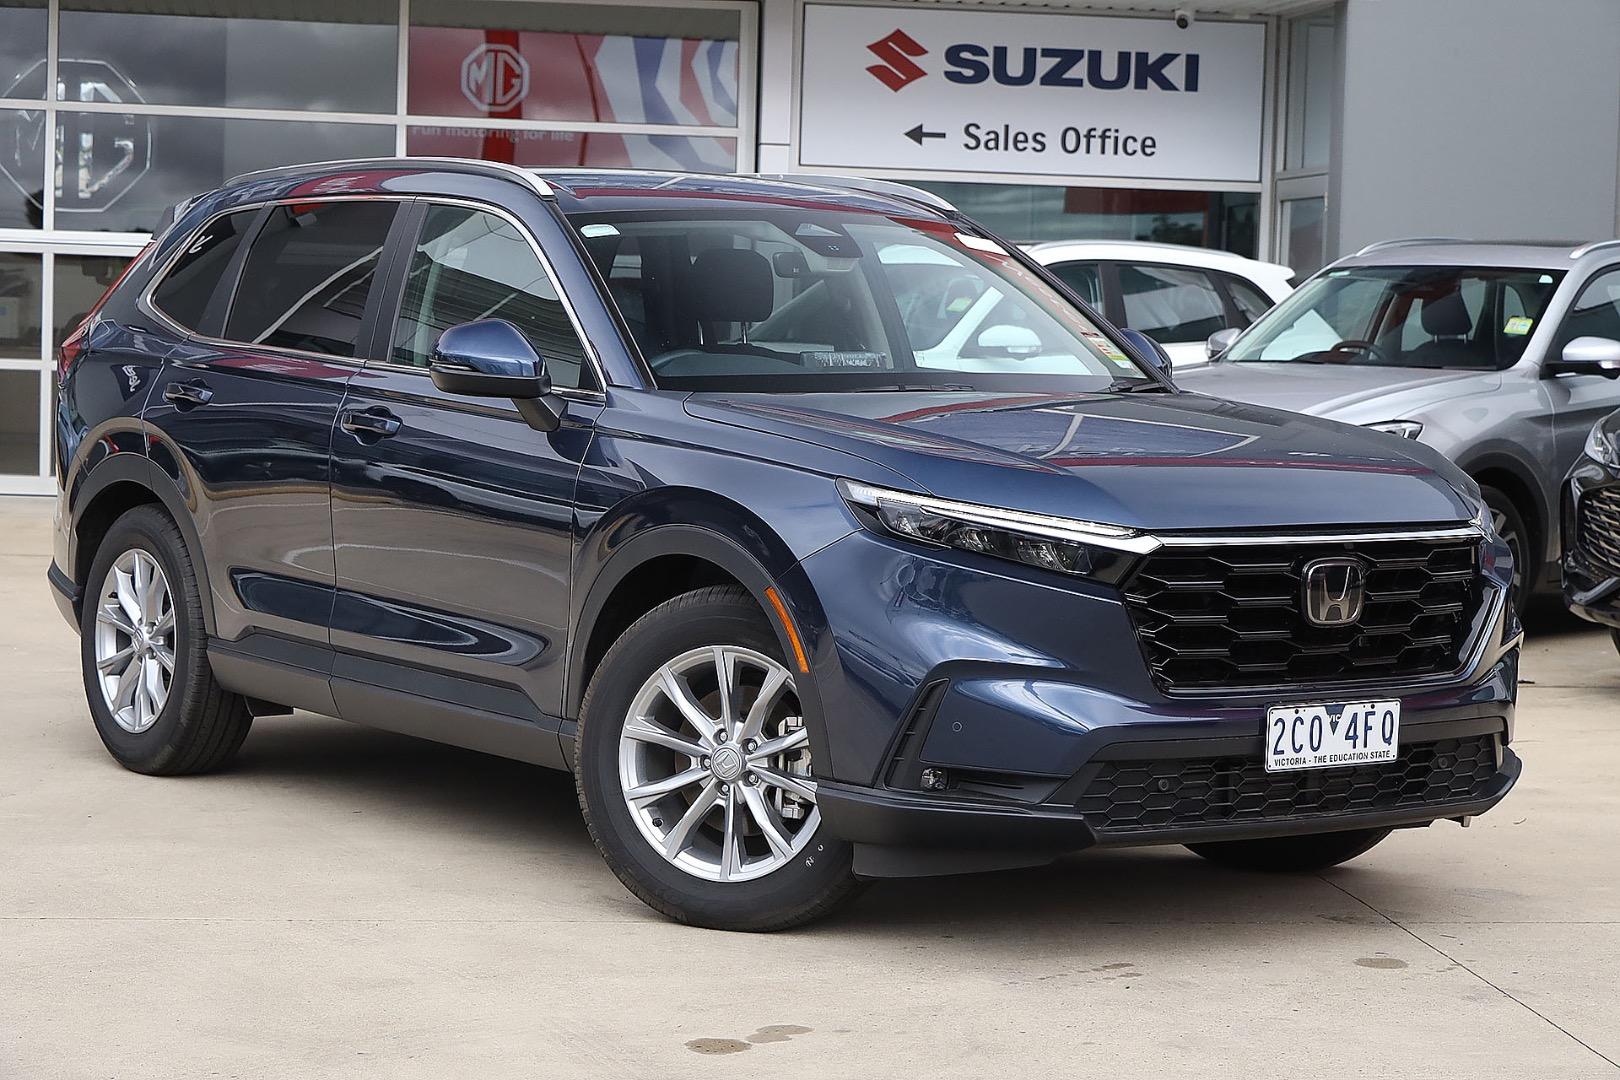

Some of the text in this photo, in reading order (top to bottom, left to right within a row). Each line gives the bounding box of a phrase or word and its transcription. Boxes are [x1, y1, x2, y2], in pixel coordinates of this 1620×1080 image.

[468, 50, 523, 106] MG
[943, 43, 1200, 93] SUZUKI
[963, 123, 1157, 157] Sales Office
[1344, 709, 1394, 749] 4FQ
[1274, 758, 1307, 767] VICTORIA
[1314, 755, 1328, 764] THE
[1329, 752, 1369, 763] EDUCATION
[1369, 750, 1391, 759] STATE
